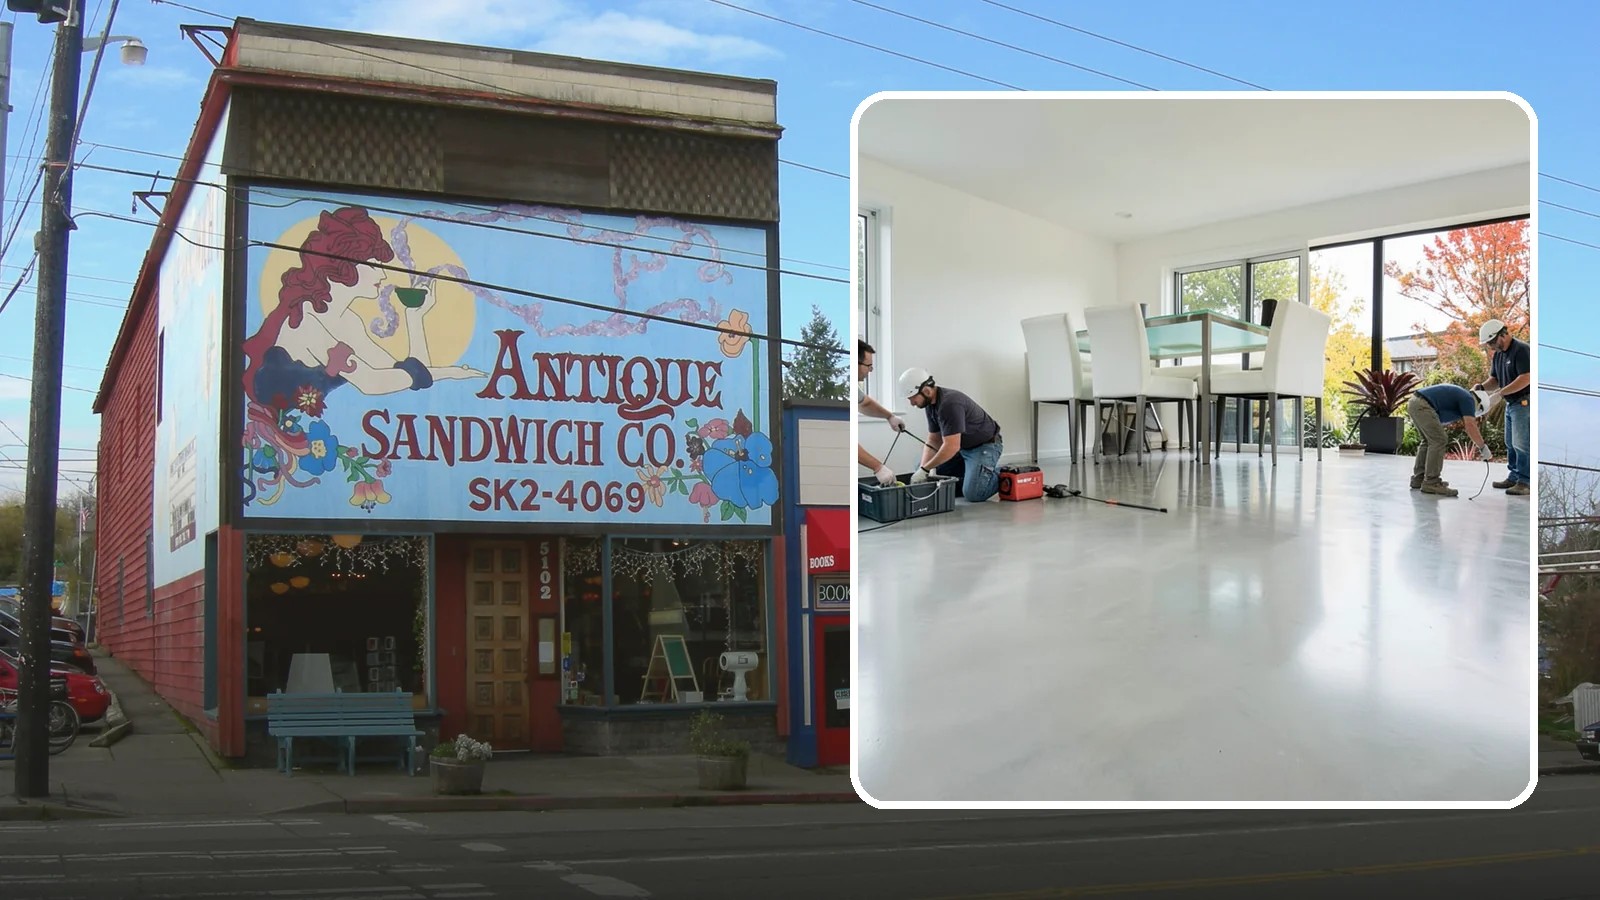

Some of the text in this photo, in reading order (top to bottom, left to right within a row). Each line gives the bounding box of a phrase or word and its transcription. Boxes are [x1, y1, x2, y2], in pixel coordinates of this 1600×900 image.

[476, 329, 723, 420] ANTIQUE
[361, 409, 684, 468] SANDWICH CO.
[468, 477, 645, 513] SK2-4069
[540, 541, 551, 600] 5102
[809, 555, 834, 569] BOOKS
